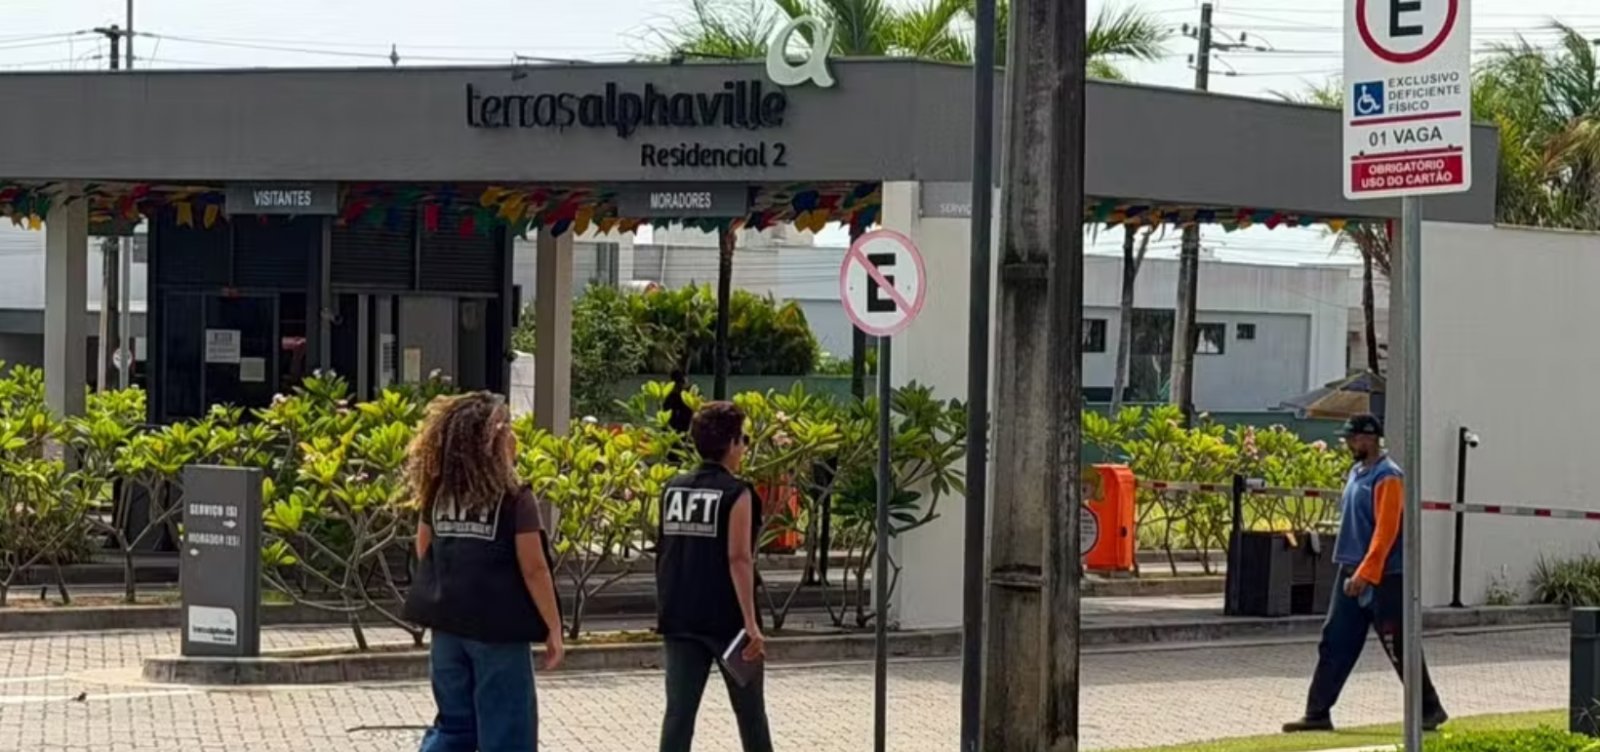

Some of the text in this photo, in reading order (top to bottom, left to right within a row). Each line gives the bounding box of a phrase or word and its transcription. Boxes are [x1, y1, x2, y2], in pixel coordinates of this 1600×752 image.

[1389, 0, 1423, 37] E
[1388, 72, 1460, 88] EXCLUSIVO
[1388, 84, 1461, 101] DEFICIENTE
[1388, 100, 1429, 113] FÍSICO
[1369, 126, 1443, 147] 01 VAGA
[641, 141, 787, 168] Residencial 2
[1368, 159, 1445, 175] OBRIGATÓRIO
[1361, 170, 1453, 188] USO DO CARTÃO
[254, 190, 312, 206] VISITANTES
[650, 191, 711, 209] MORADORES
[867, 253, 897, 313] E
[666, 491, 718, 522] AFT
